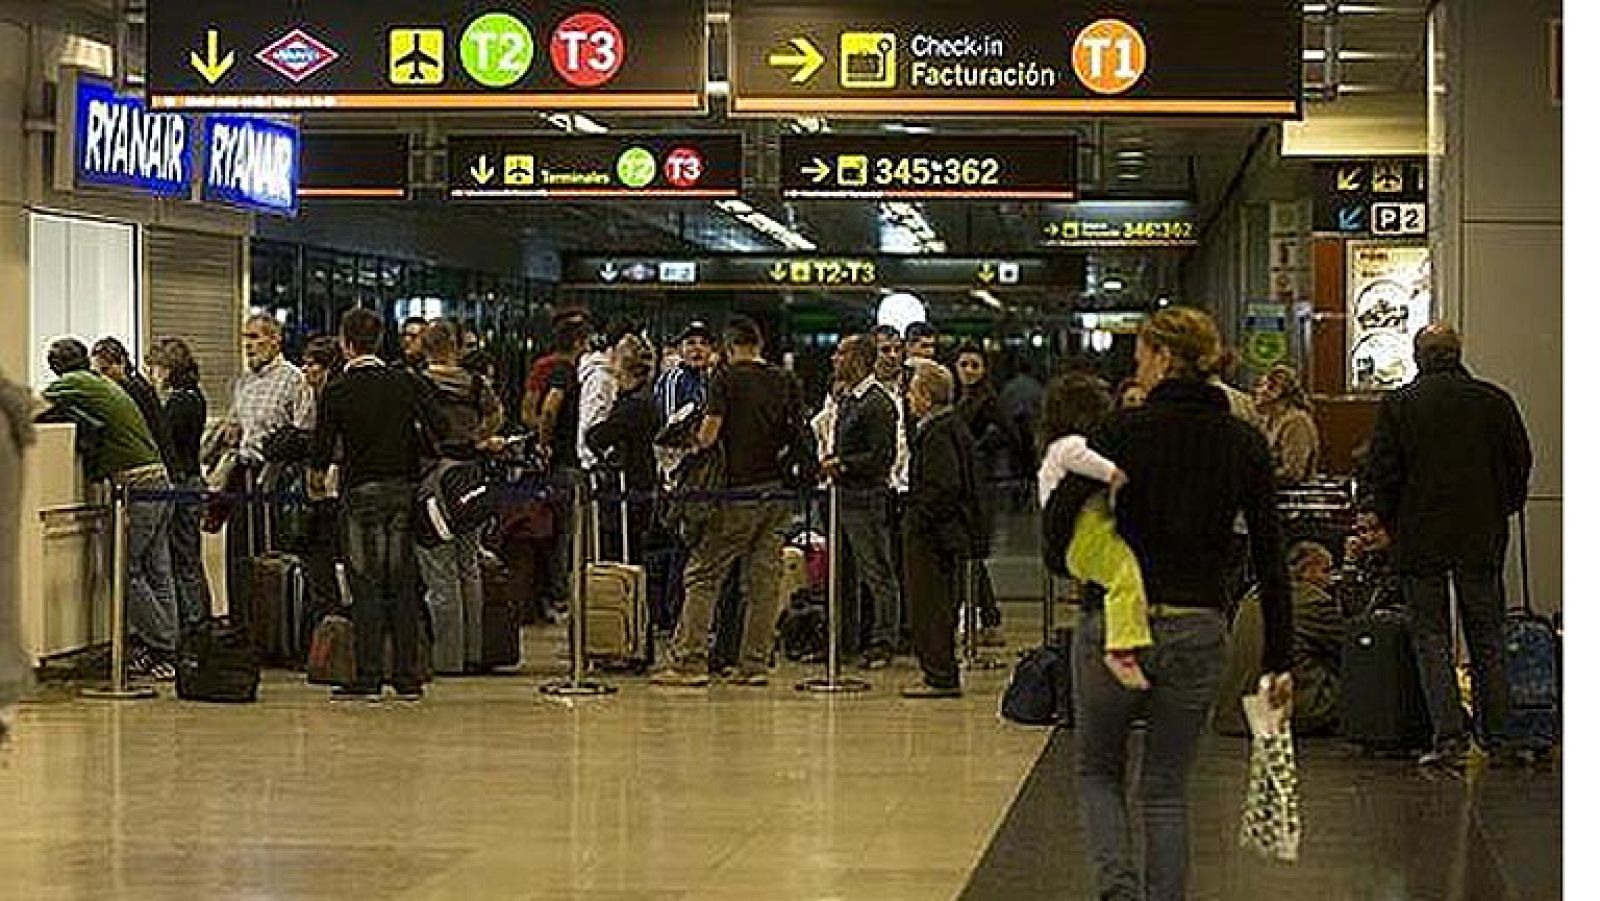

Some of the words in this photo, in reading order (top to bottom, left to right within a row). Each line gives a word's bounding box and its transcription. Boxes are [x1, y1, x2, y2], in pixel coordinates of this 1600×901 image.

[470, 32, 524, 71] T2
[559, 31, 616, 71] T3
[911, 35, 1003, 57] Check-in
[1083, 37, 1136, 79] T1
[911, 62, 1055, 87] Facturación
[85, 100, 184, 183] RYANAIR
[666, 157, 701, 180] T3
